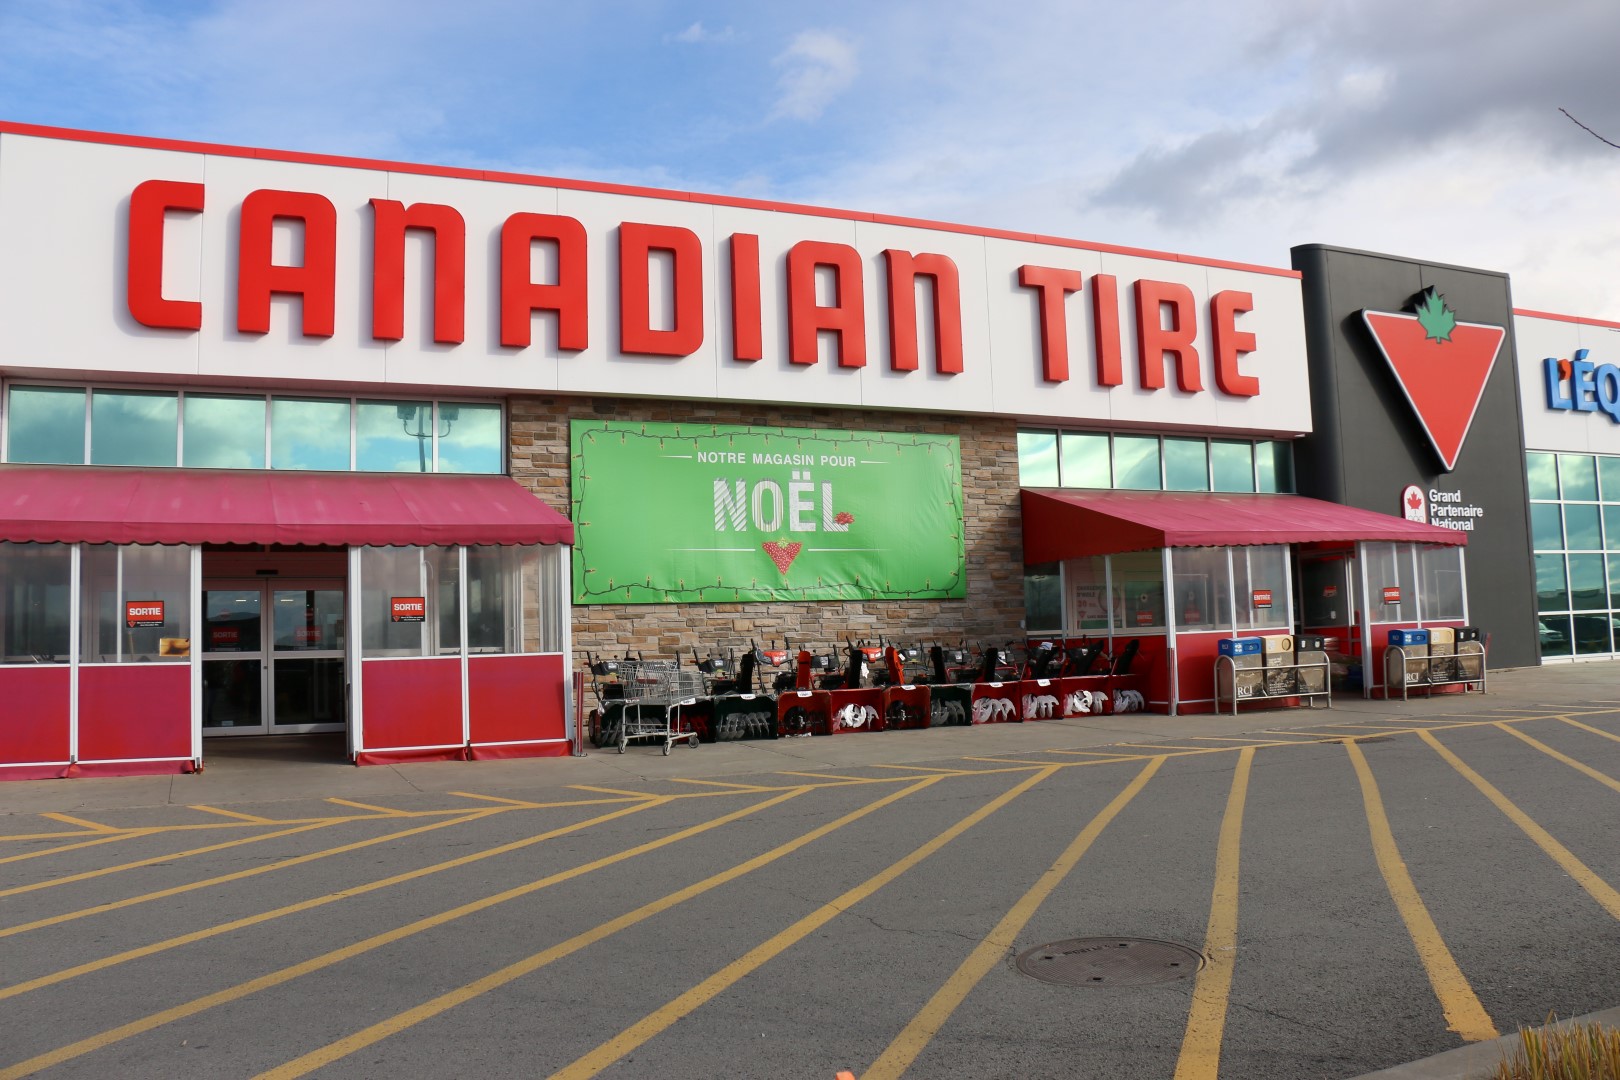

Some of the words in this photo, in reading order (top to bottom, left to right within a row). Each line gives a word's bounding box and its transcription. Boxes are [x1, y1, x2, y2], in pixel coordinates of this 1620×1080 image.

[127, 179, 964, 375] CANADIAN
[1018, 265, 1260, 397] TIRE
[1543, 348, 1620, 424] L'ÉQ
[697, 452, 746, 464] NOTRE
[753, 453, 814, 465] MAGASIN
[821, 455, 856, 467] POUR
[713, 469, 849, 532] NOËL
[1429, 489, 1461, 503] Grand
[1430, 504, 1484, 517] Partenaire
[1432, 518, 1474, 531] National
[129, 607, 162, 616] SORTIE
[394, 603, 422, 611] SORTIE
[213, 631, 238, 639] SORTIE
[1237, 685, 1253, 696] RCI
